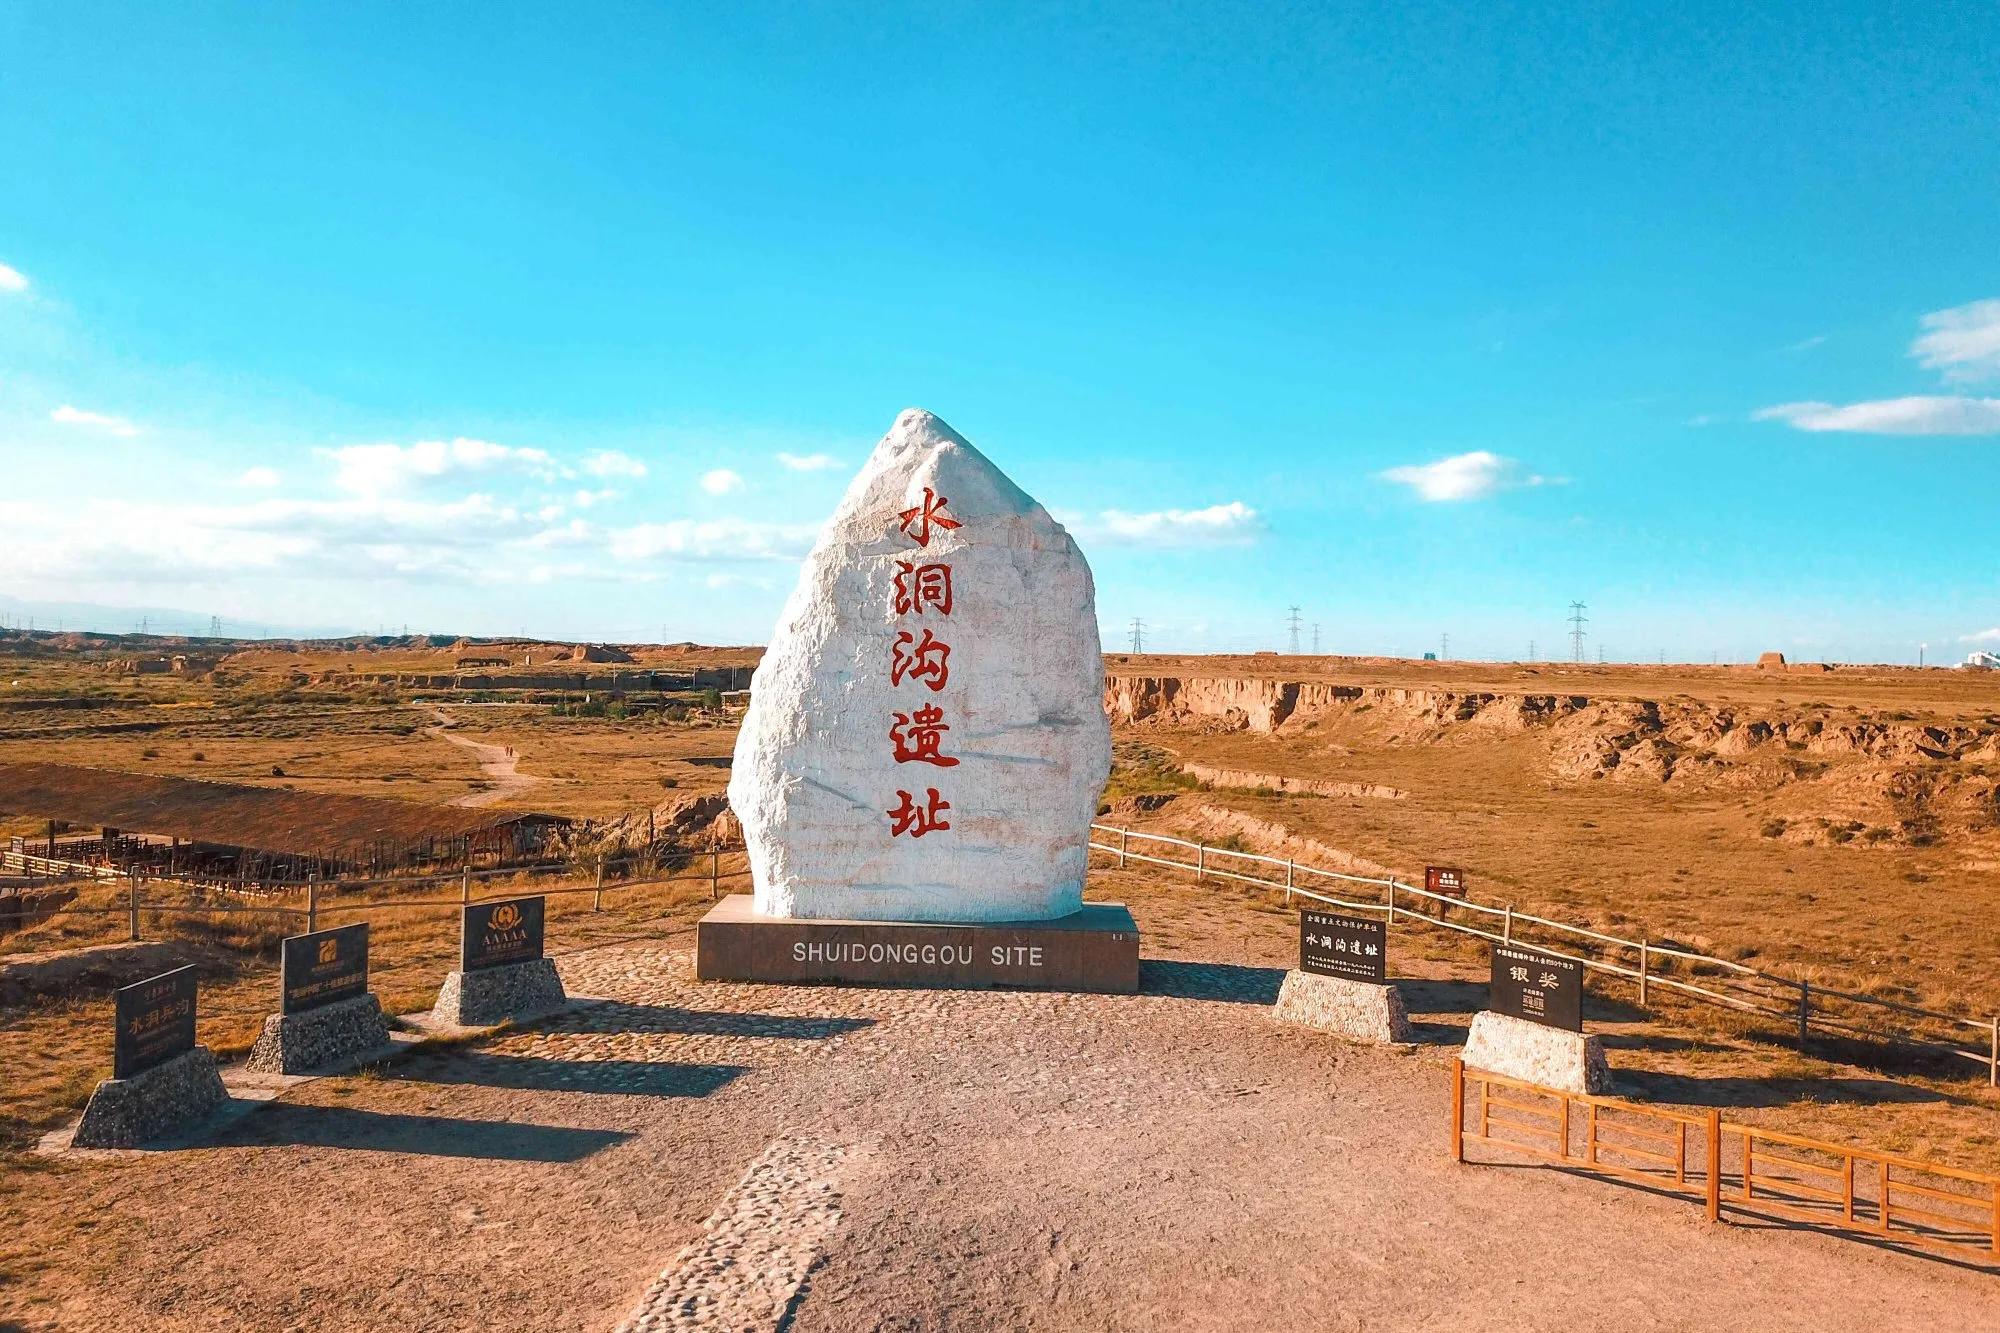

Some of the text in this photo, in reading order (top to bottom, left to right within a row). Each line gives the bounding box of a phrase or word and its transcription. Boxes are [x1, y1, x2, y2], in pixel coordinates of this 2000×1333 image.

[886, 488, 960, 838] 水洞沟遗址
[1306, 914, 1378, 932] 全国重点文物保护单位
[793, 942, 1044, 966] SHUIDONGGOU SITE
[1306, 932, 1378, 956] 水洞沟遗址
[1509, 965, 1560, 990] 银奖
